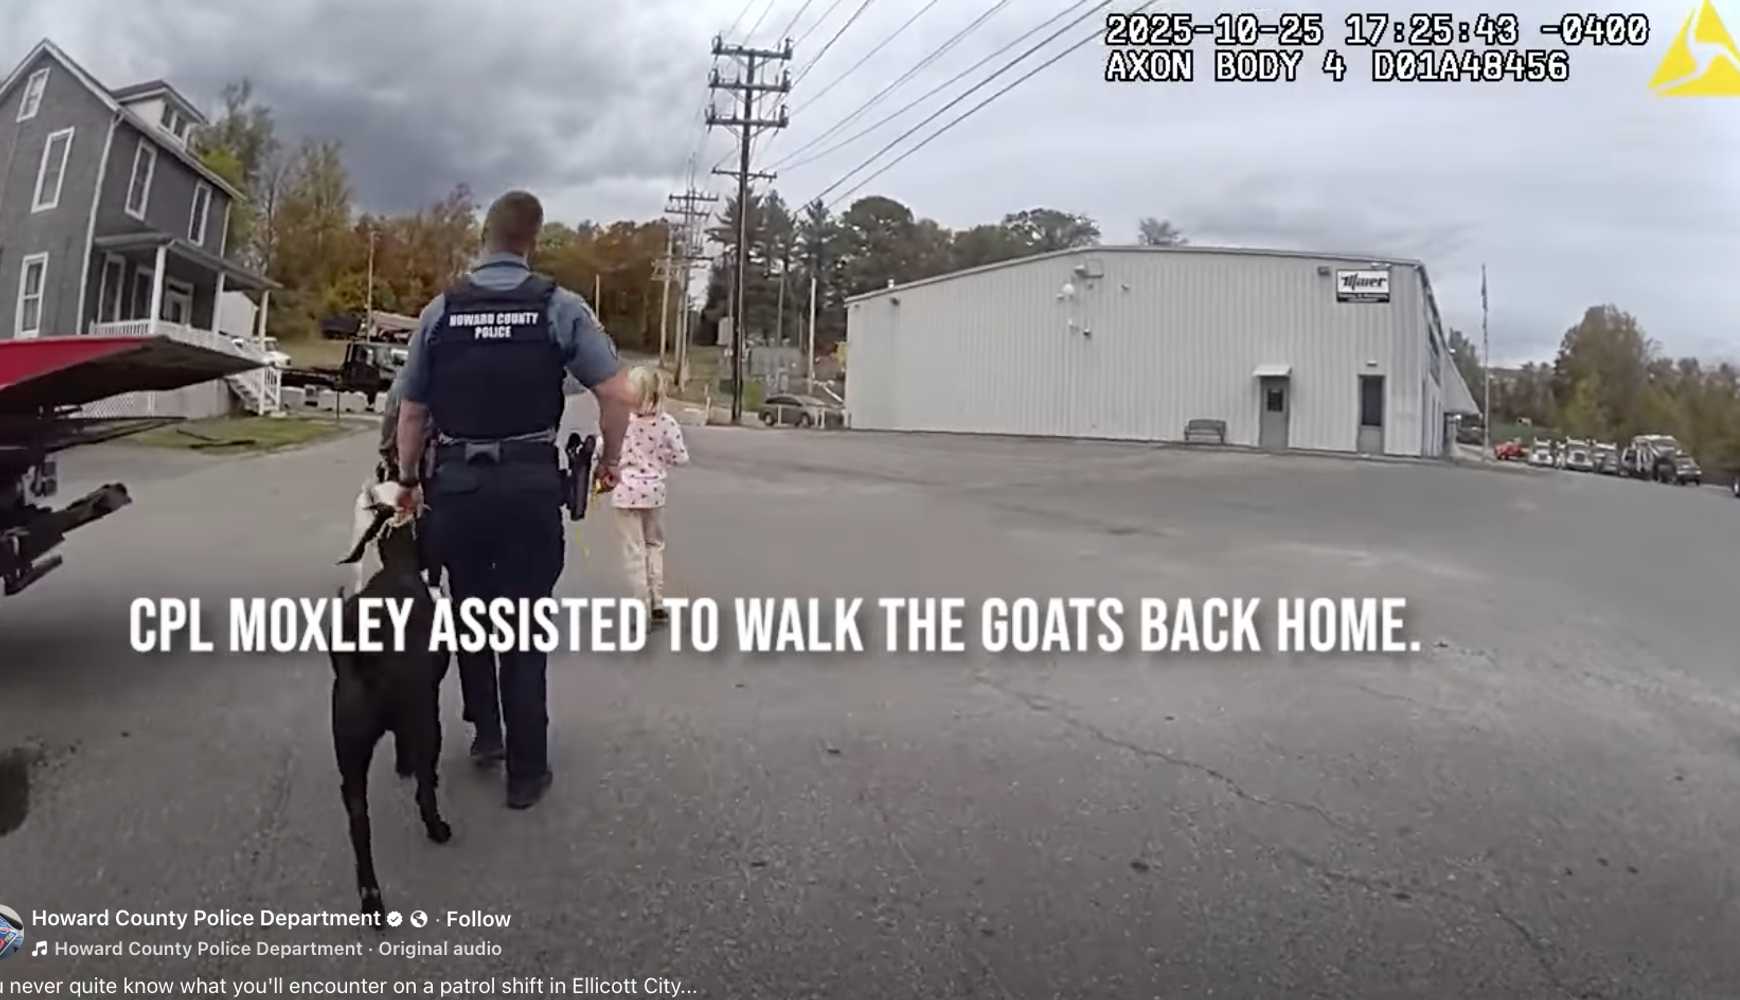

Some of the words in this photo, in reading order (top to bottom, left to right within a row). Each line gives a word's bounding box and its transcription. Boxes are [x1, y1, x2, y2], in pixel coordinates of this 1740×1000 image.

[449, 313, 495, 327] HOWARD
[496, 312, 539, 325] COUNTY
[475, 325, 512, 339] POLICE
